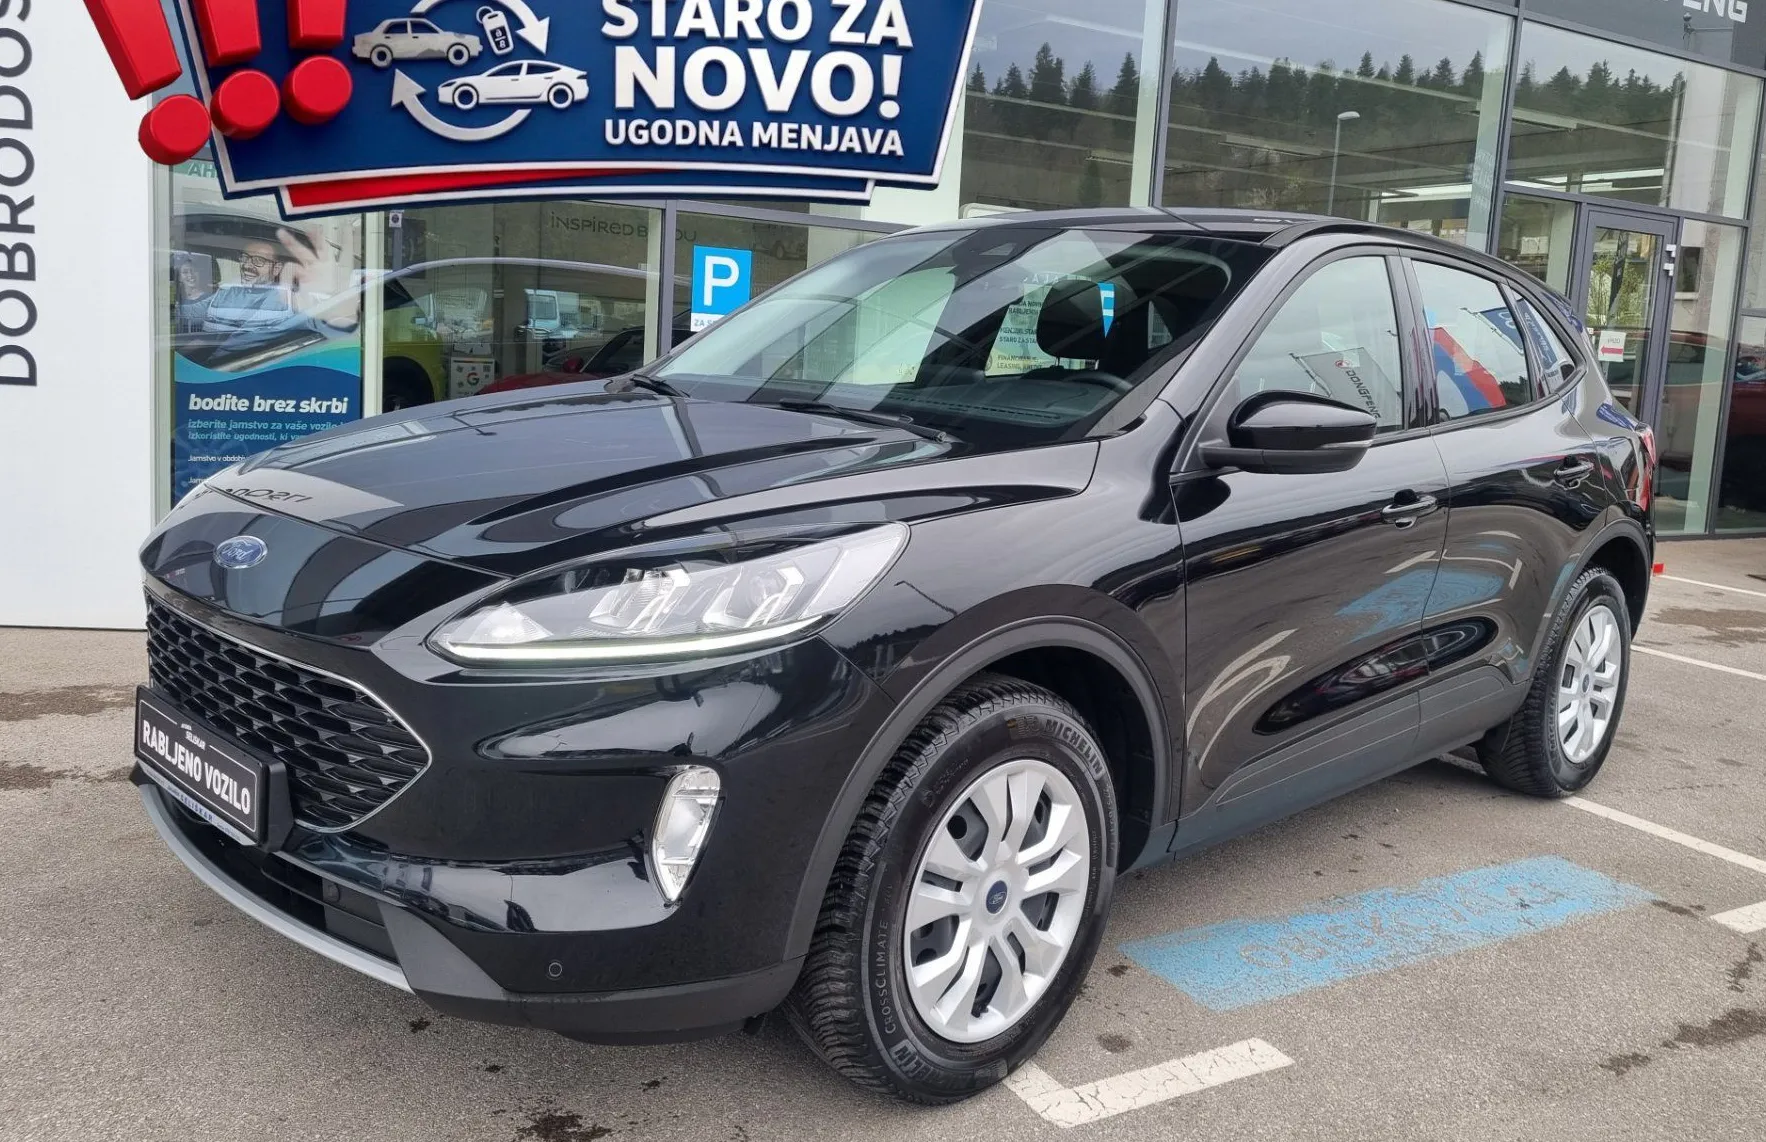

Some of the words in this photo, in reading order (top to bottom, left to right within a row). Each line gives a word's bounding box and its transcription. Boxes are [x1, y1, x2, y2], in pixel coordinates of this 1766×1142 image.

[703, 255, 739, 306] P
[188, 394, 249, 411] bodite
[253, 396, 296, 413] brez
[299, 397, 349, 414] skrbi
[188, 419, 227, 429] izberite
[228, 420, 269, 431] jamstvo
[284, 420, 308, 430] vaše
[188, 431, 230, 440] izkoristite
[233, 432, 277, 442] ugodnosti,
[221, 541, 254, 561] Ford
[1044, 718, 1104, 776] MICHELIN
[142, 719, 202, 782] RABLJENO
[204, 761, 251, 815] VOZILO
